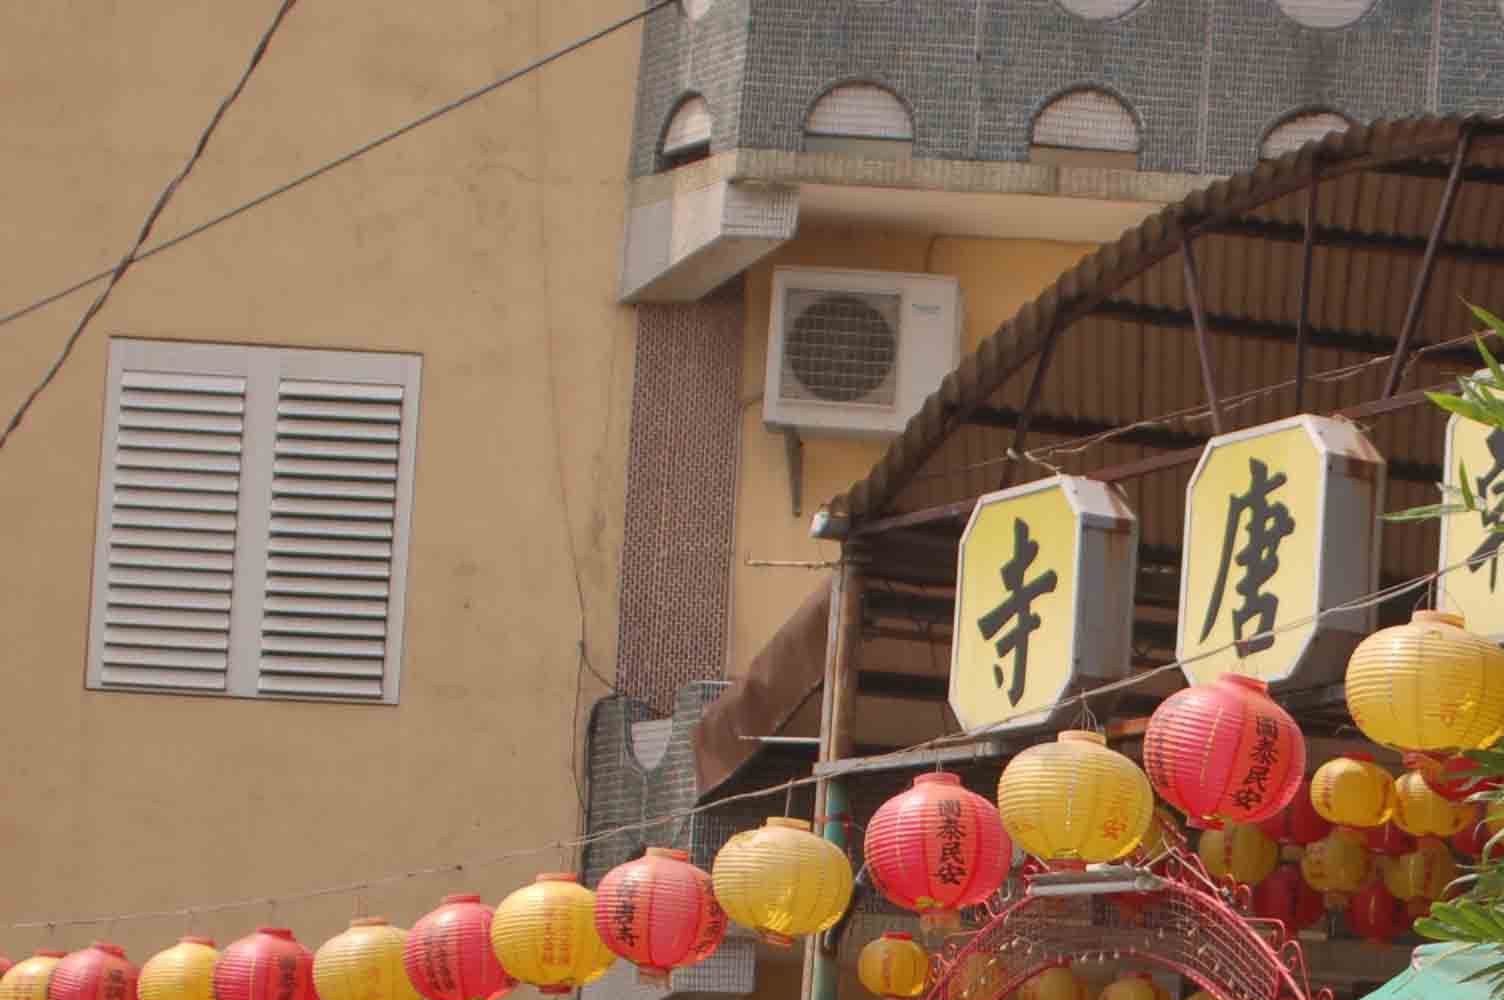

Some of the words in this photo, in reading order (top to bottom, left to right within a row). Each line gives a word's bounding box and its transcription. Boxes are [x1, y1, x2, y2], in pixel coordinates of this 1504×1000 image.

[1233, 714, 1280, 811] 國泰民安
[935, 799, 967, 885] 國泰民安
